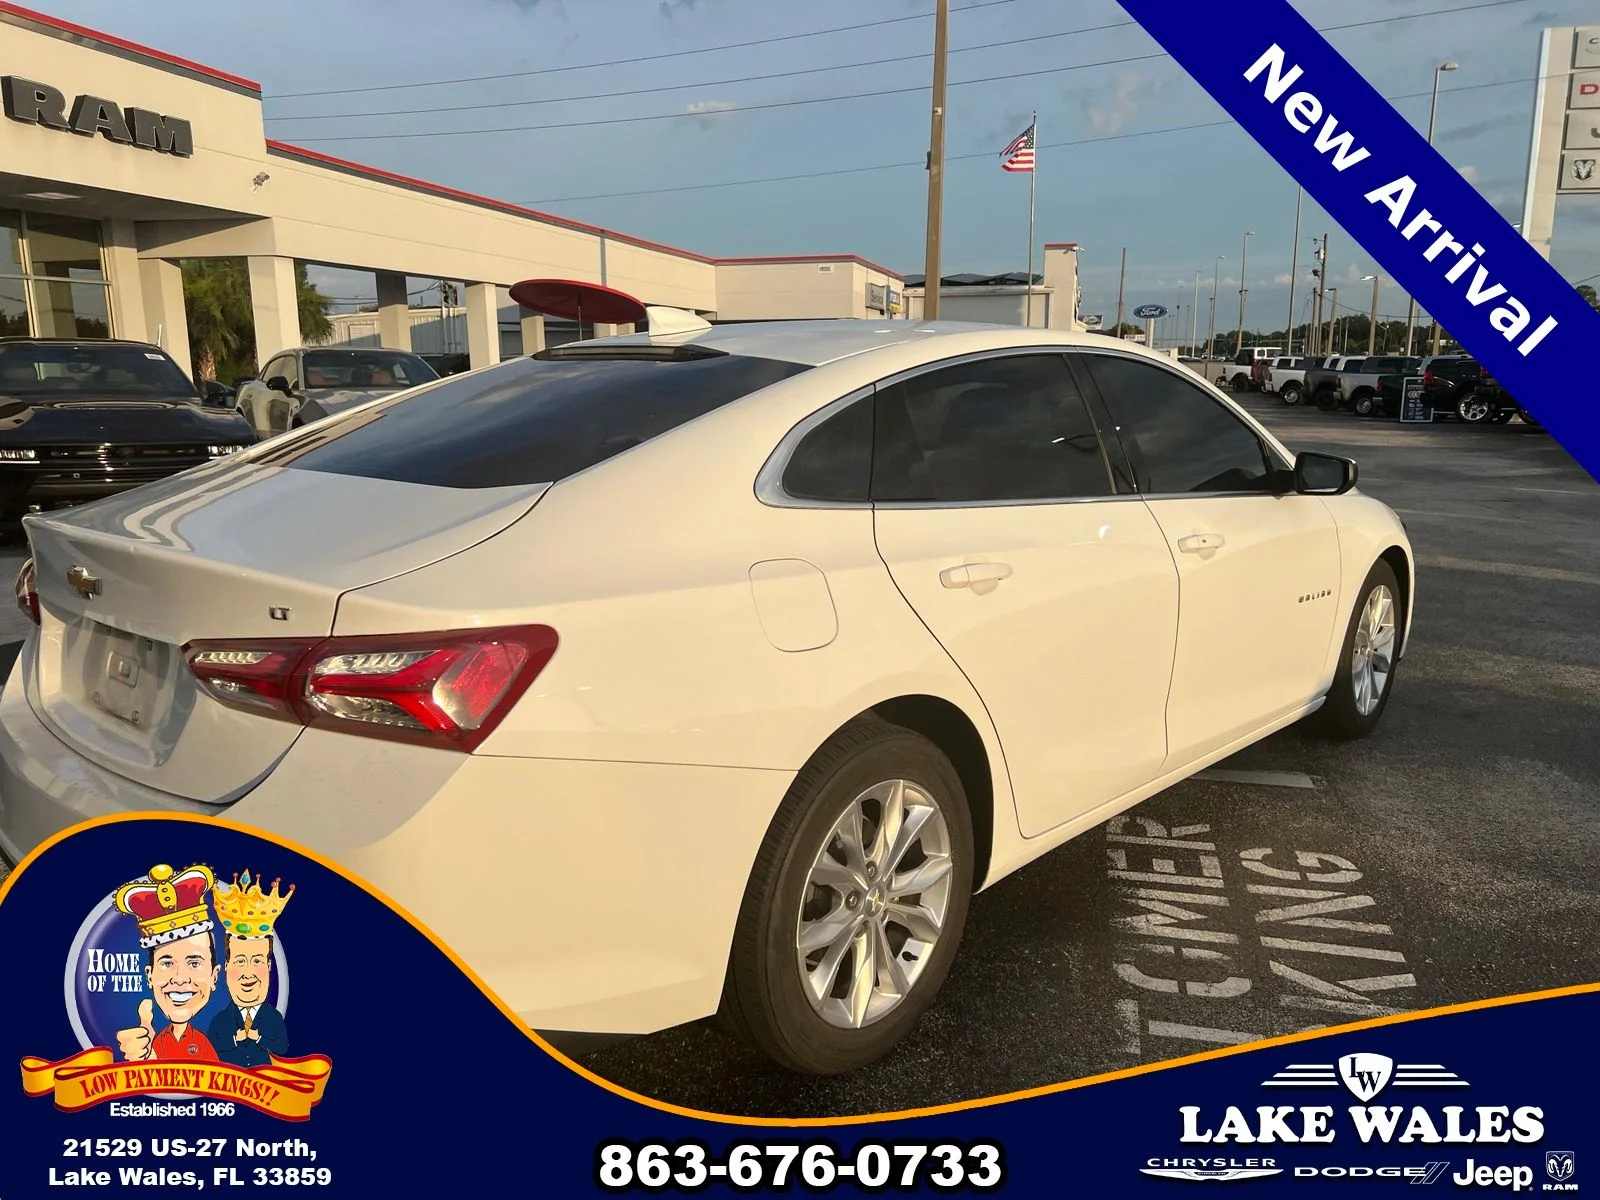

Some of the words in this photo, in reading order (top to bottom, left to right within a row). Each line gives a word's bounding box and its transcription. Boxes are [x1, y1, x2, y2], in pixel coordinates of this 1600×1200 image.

[1, 75, 194, 159] RAM
[1140, 307, 1160, 316] Ford
[269, 606, 291, 621] LT
